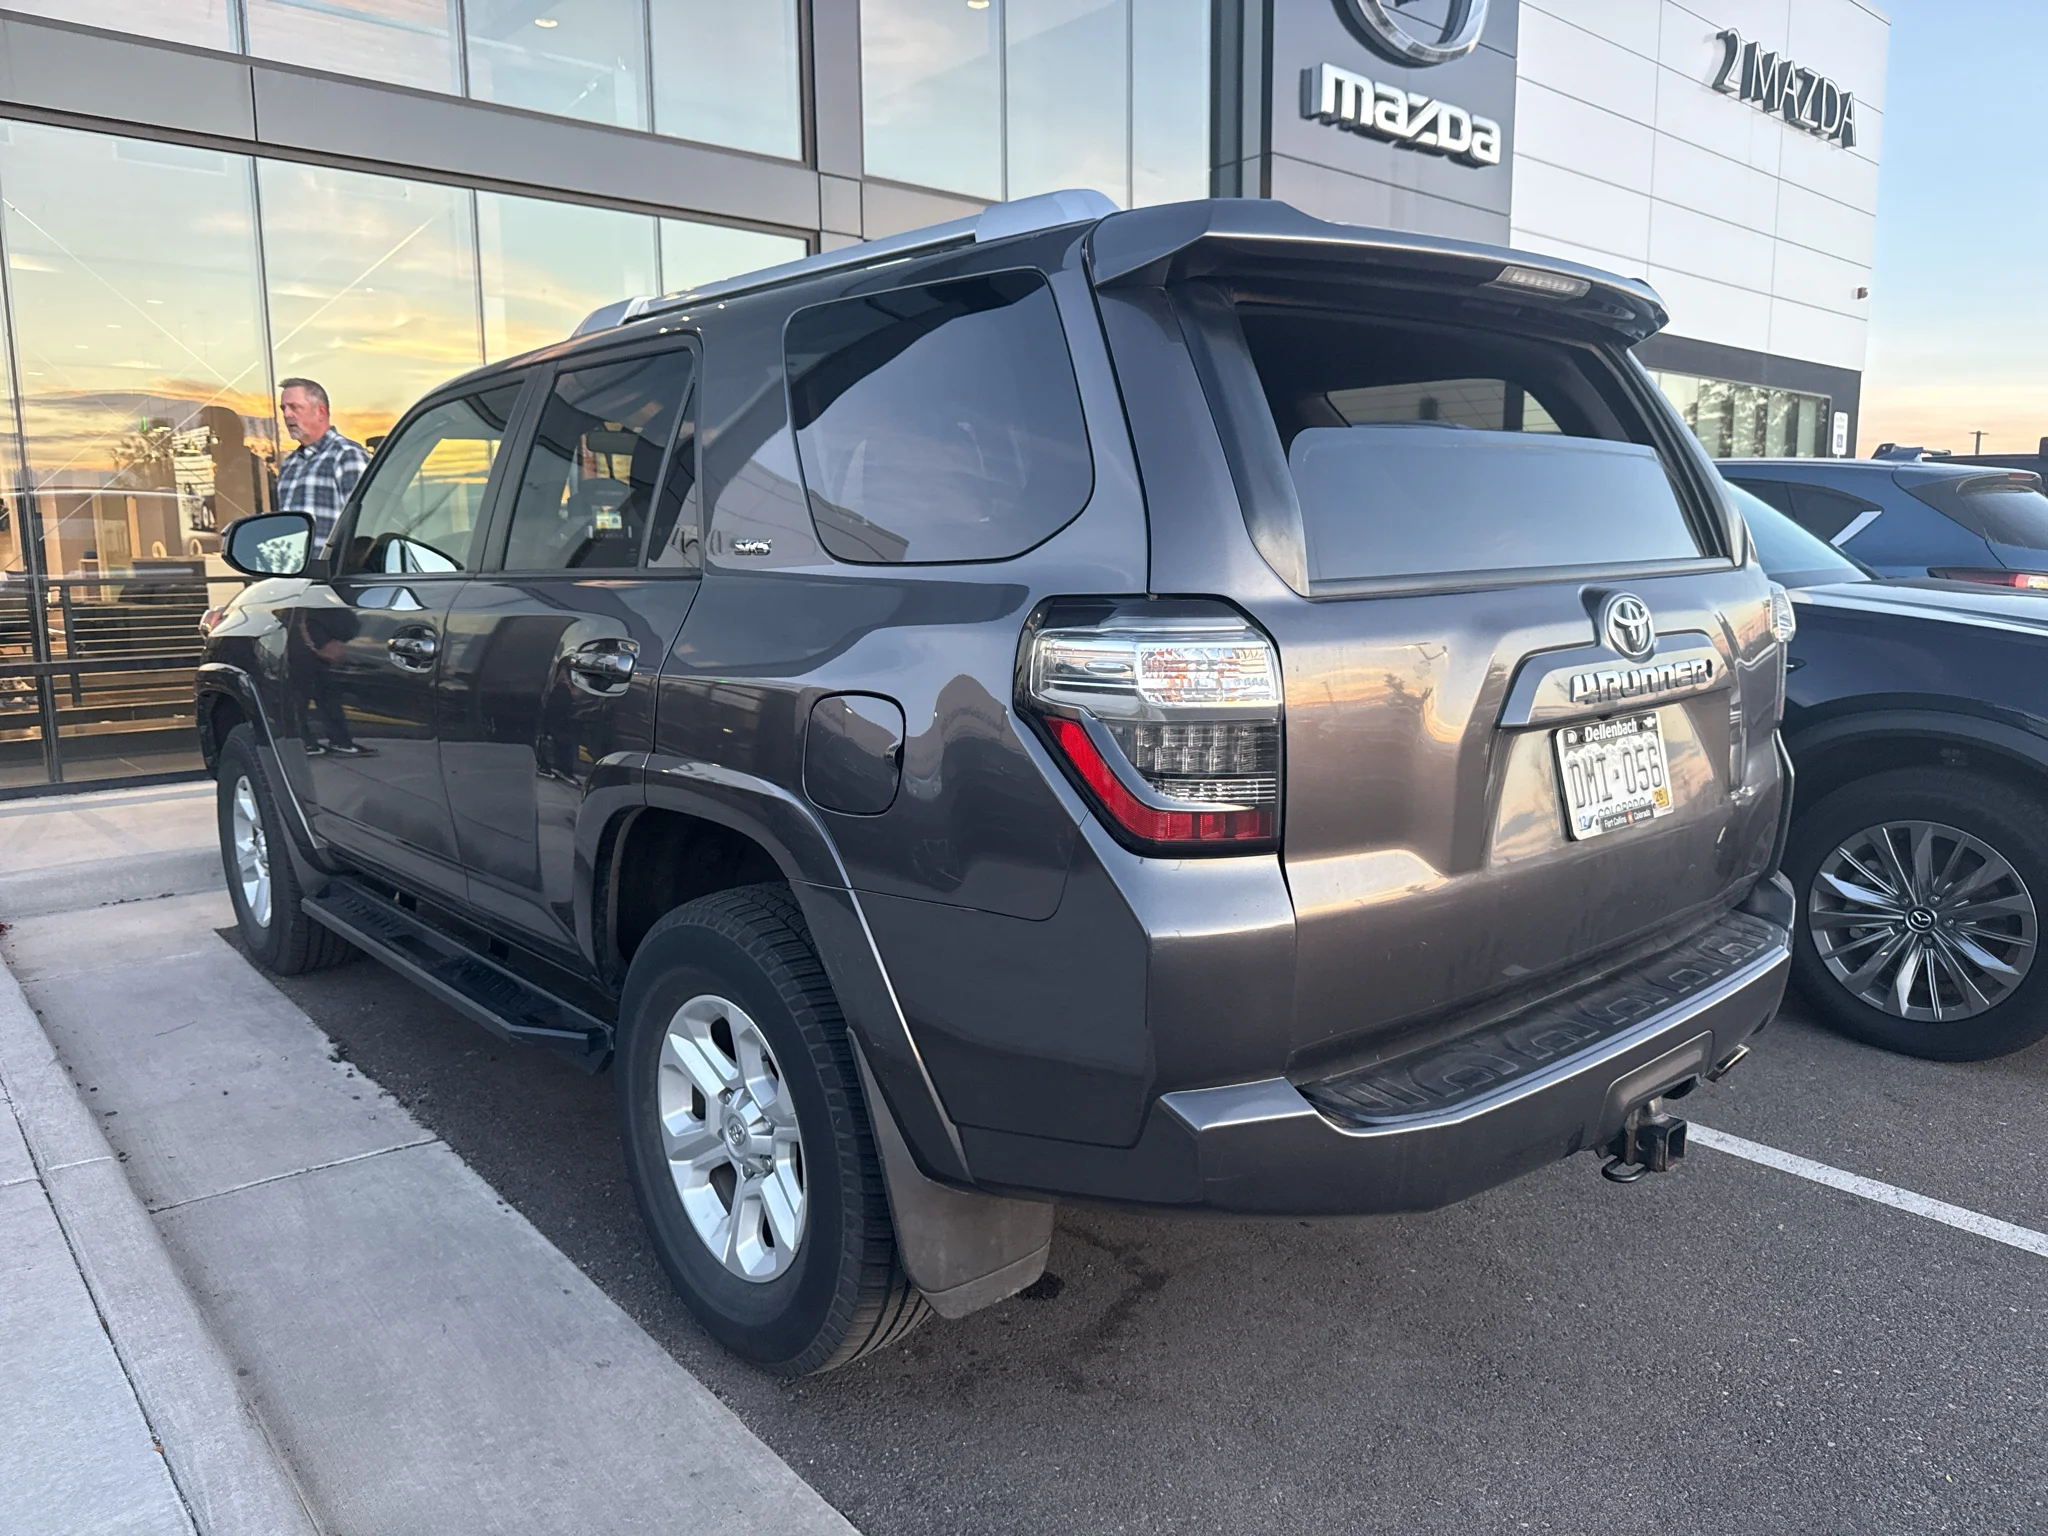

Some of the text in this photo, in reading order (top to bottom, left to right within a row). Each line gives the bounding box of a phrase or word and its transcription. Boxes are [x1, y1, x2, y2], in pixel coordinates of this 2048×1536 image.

[1740, 41, 1857, 148] MAZDA
[1585, 717, 1638, 743] Dellenbach
[1654, 790, 1664, 802] 26
[1578, 815, 1588, 829] 12
[1612, 814, 1627, 826] Collins
[1633, 808, 1651, 819] Colorado
